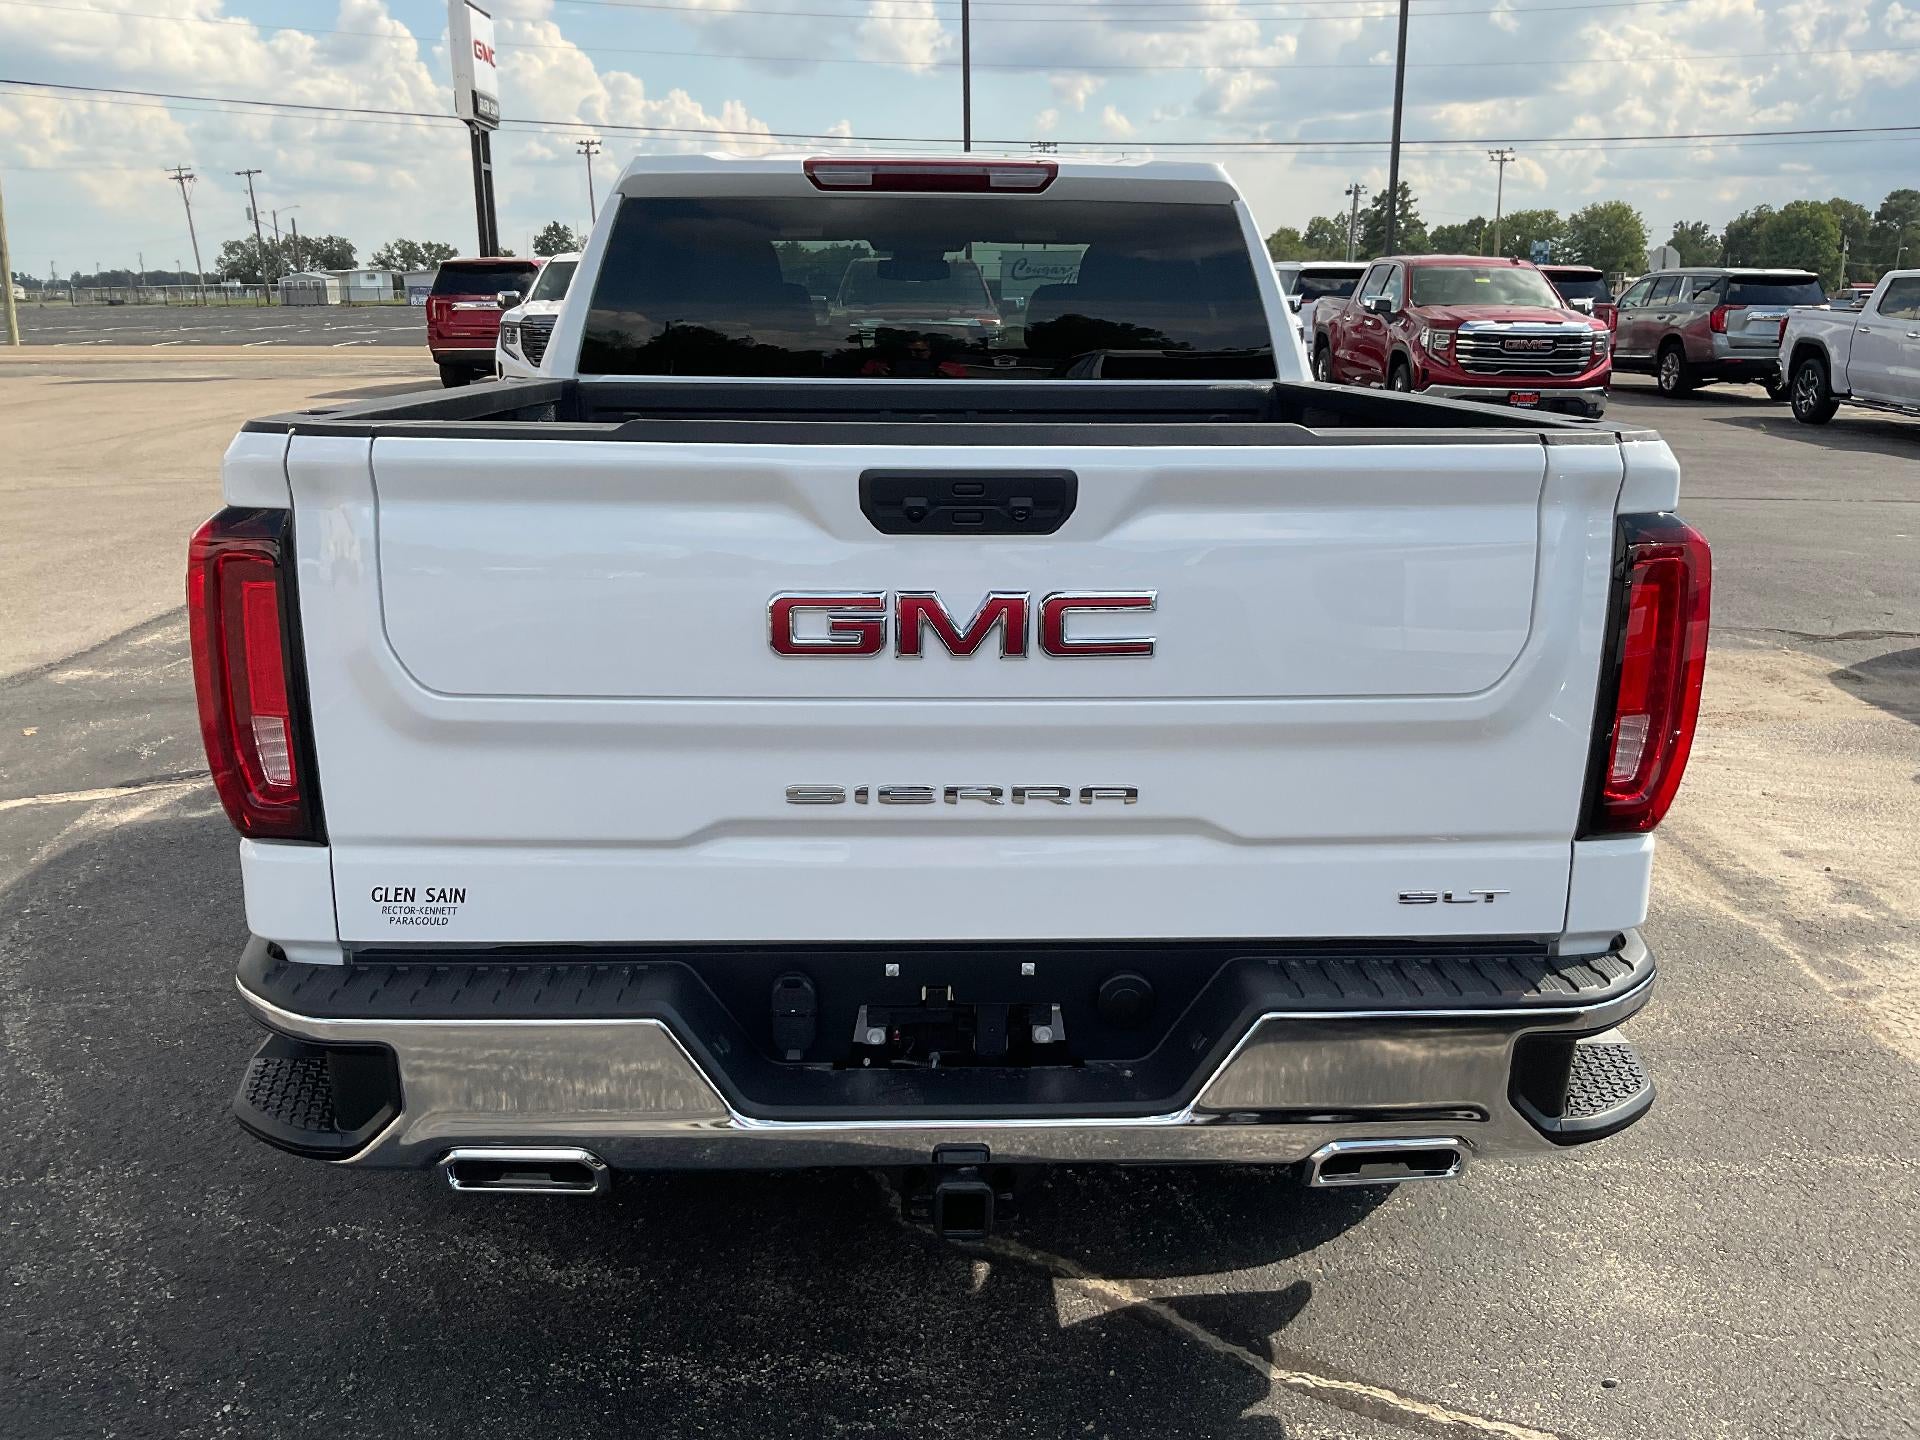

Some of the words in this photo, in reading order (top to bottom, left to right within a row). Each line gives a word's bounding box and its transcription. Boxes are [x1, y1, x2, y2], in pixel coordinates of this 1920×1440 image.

[473, 39, 496, 68] GMC
[1504, 339, 1554, 349] GMC
[767, 589, 1158, 660] GMC
[785, 783, 1139, 806] SIERRA
[371, 886, 416, 903] GLEN
[425, 887, 466, 904] SAIN
[1398, 889, 1511, 905] SLT
[381, 905, 458, 916] RECTOR-KENNETT
[389, 916, 449, 926] PARAGOULD
